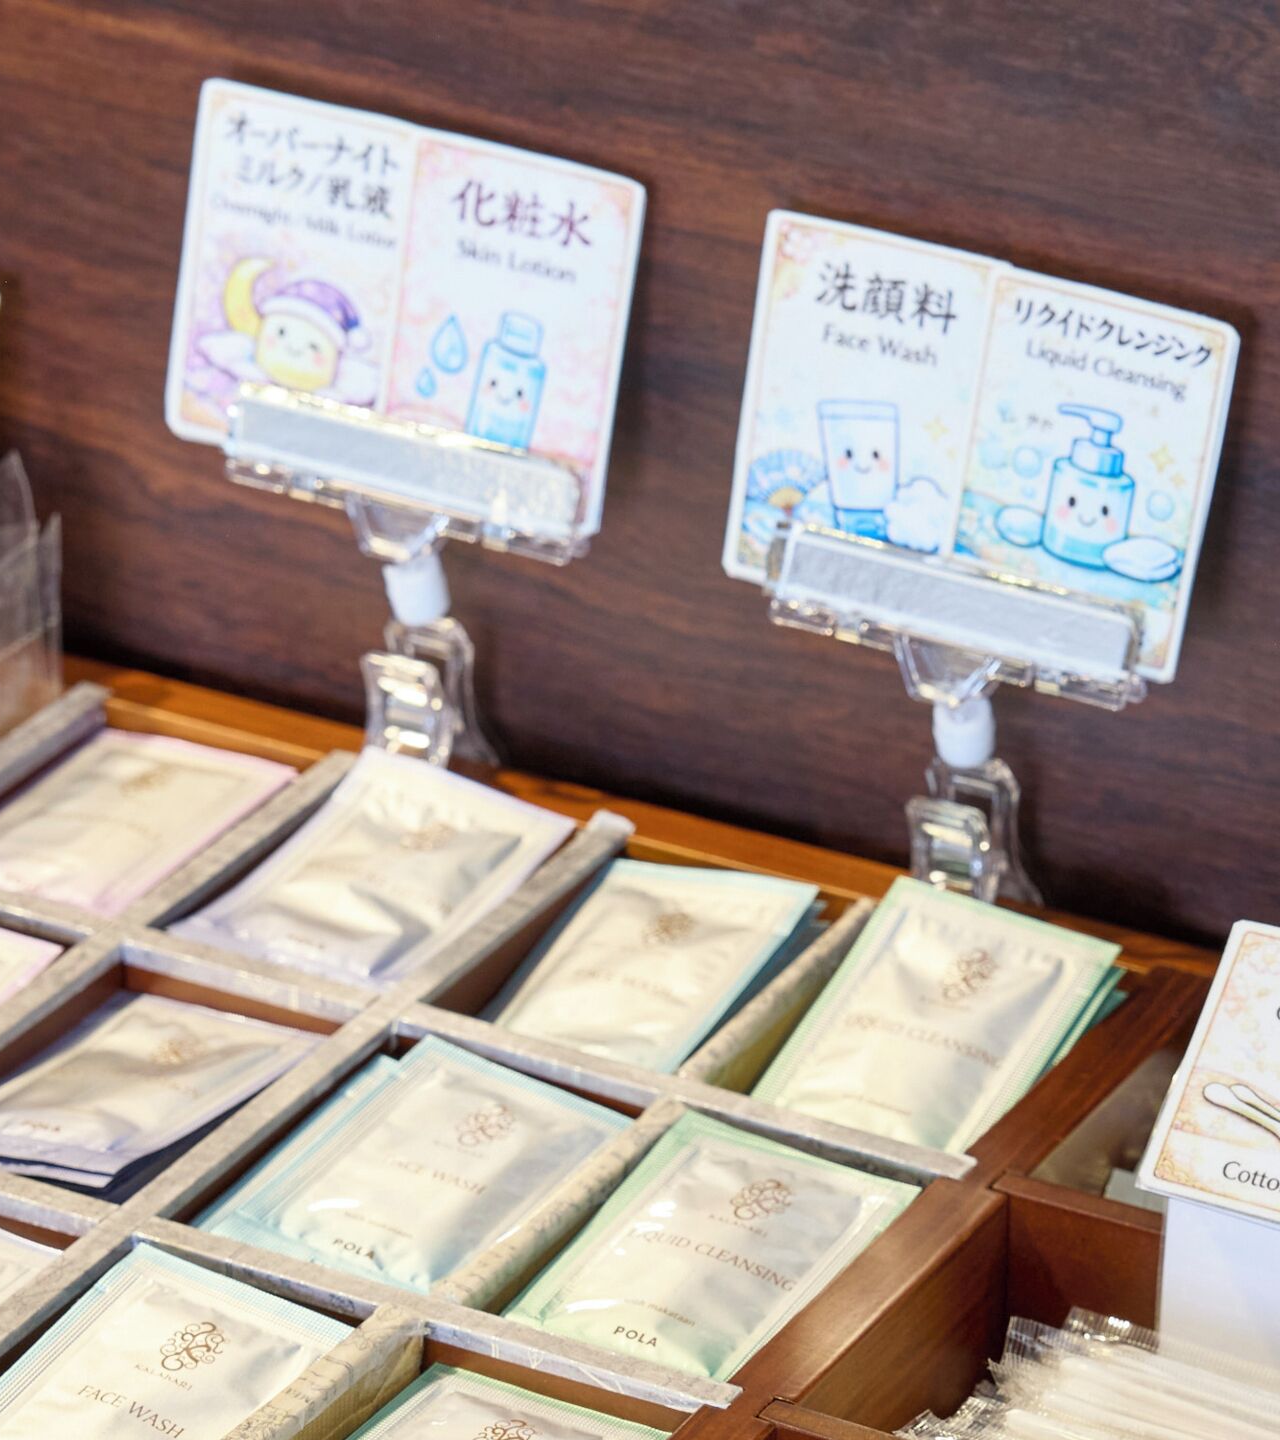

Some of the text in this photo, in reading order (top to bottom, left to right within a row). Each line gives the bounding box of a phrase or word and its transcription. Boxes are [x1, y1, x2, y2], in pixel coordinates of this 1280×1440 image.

[224, 109, 401, 172] オーバーナイト
[455, 178, 593, 248] 化粧水
[456, 238, 578, 284] Skin Lotion
[813, 260, 960, 336] 洗顔料
[822, 322, 939, 368] Face Wash
[1025, 338, 1188, 403] Liquid Cleansing
[332, 1236, 377, 1262] POLA
[693, 1241, 799, 1293] CLEANSING
[612, 1324, 659, 1349] POLA
[76, 1384, 186, 1440] FACE WASH
